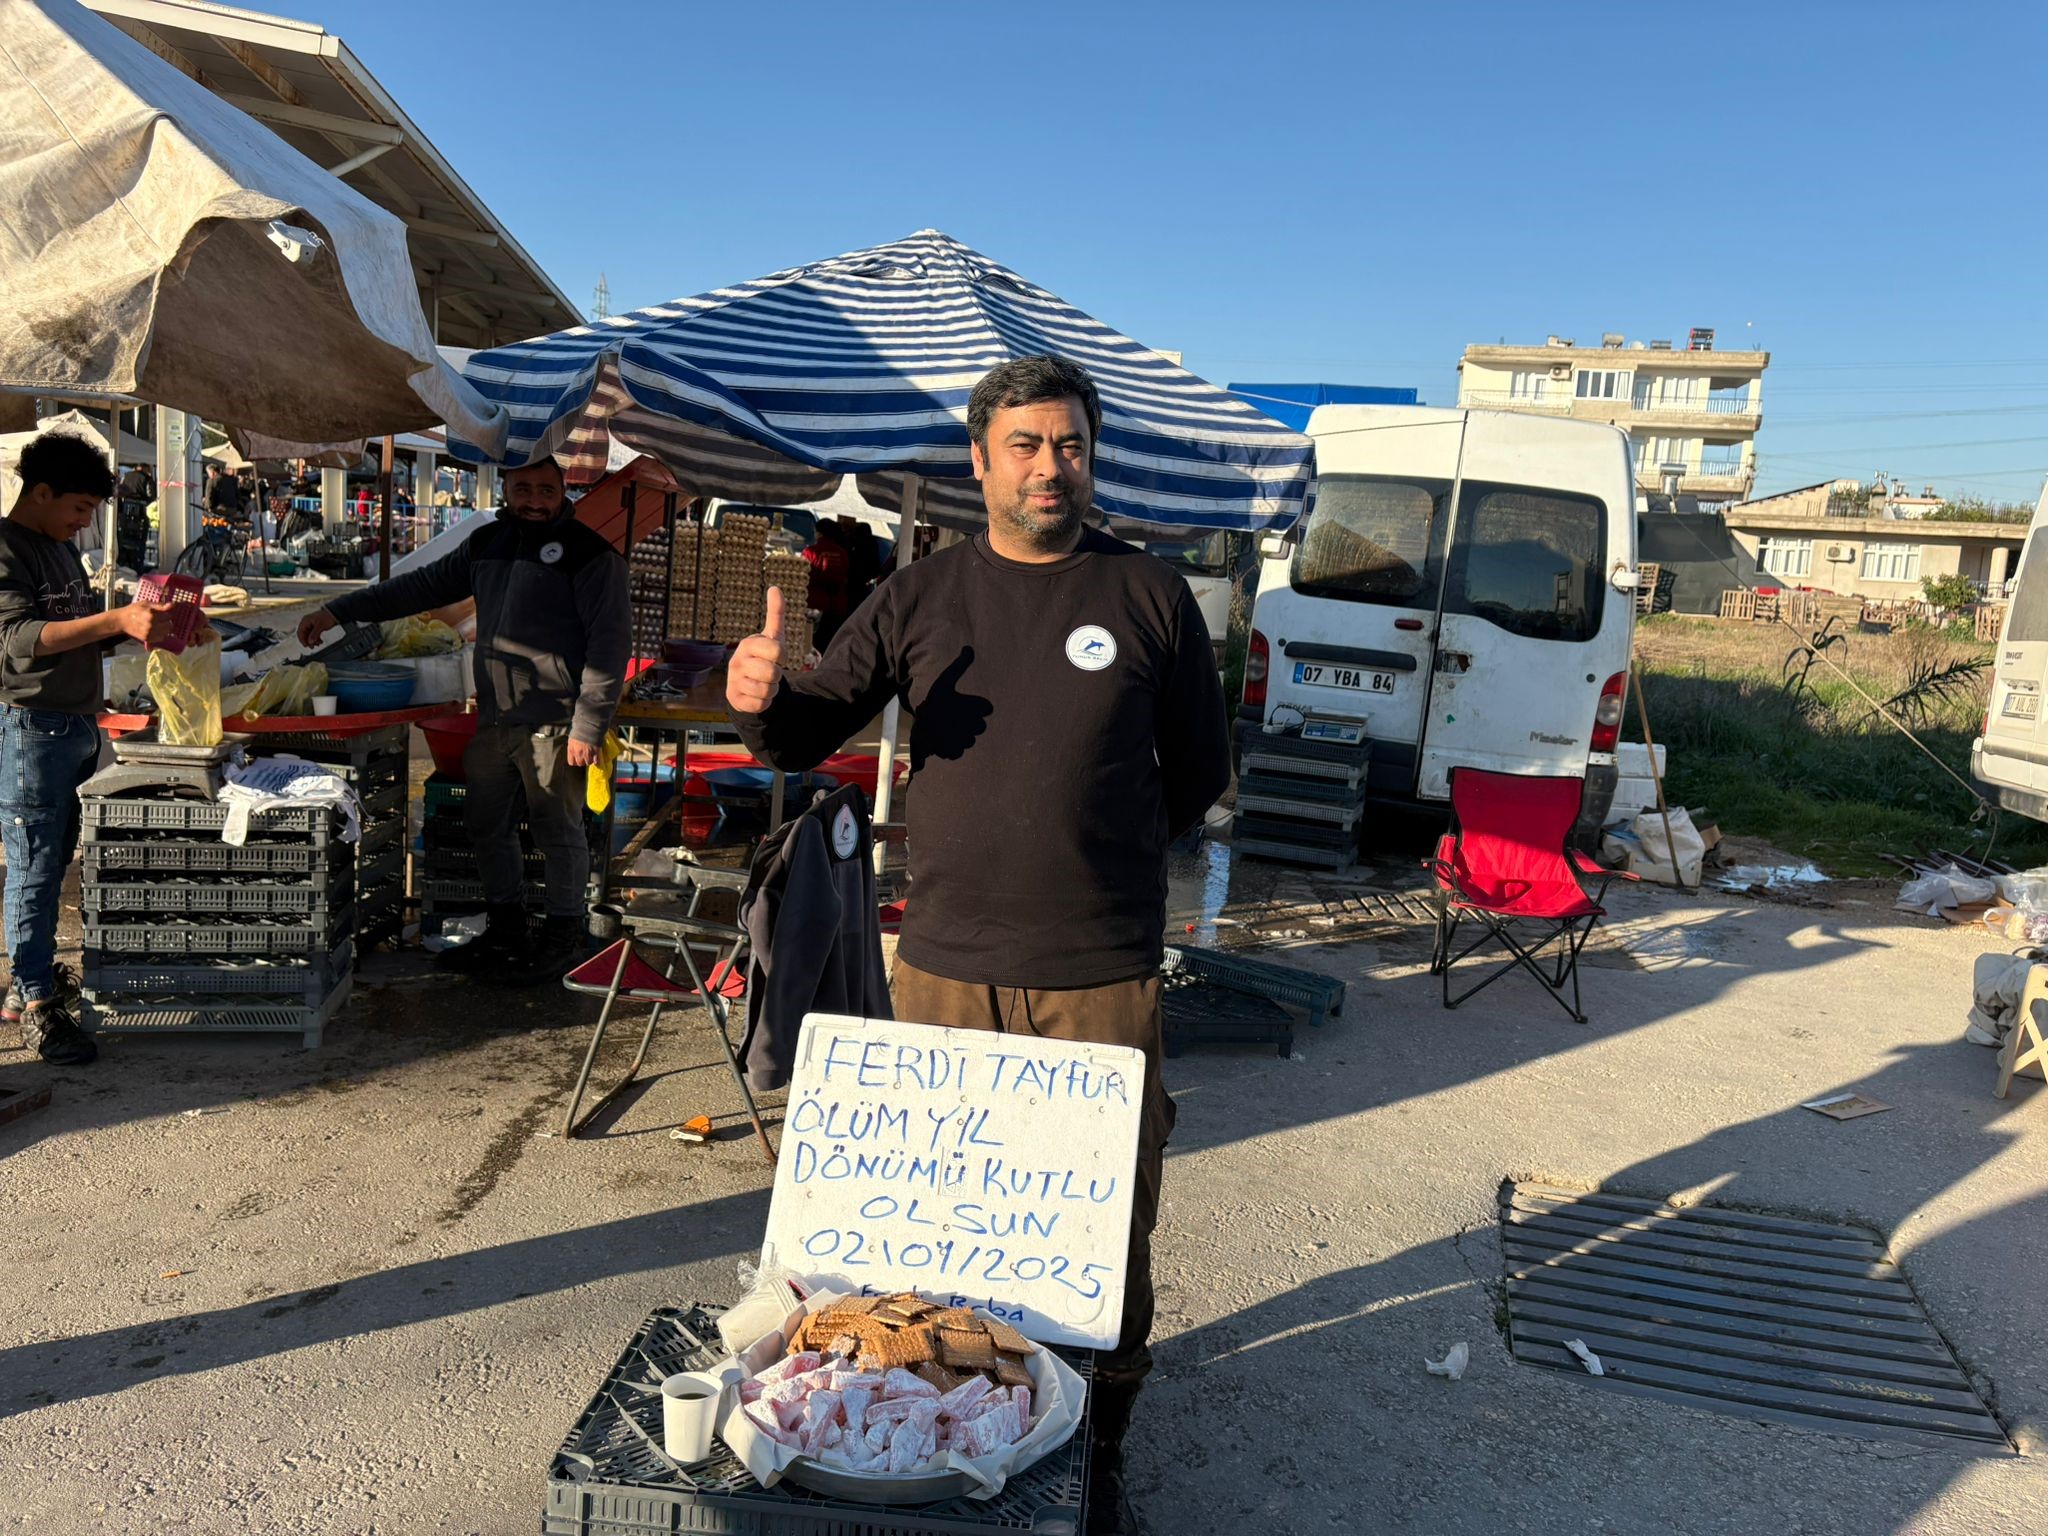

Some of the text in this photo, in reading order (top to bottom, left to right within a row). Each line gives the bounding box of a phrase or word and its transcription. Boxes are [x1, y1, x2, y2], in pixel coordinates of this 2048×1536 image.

[1303, 666, 1391, 691] 07 YBA 84
[985, 1053, 1128, 1105] TAYFUR
[790, 1087, 909, 1143] ÖLÜM
[793, 1140, 1115, 1203] DÖNÜMÜ KUTLU
[949, 1295, 1024, 1322] Bba
